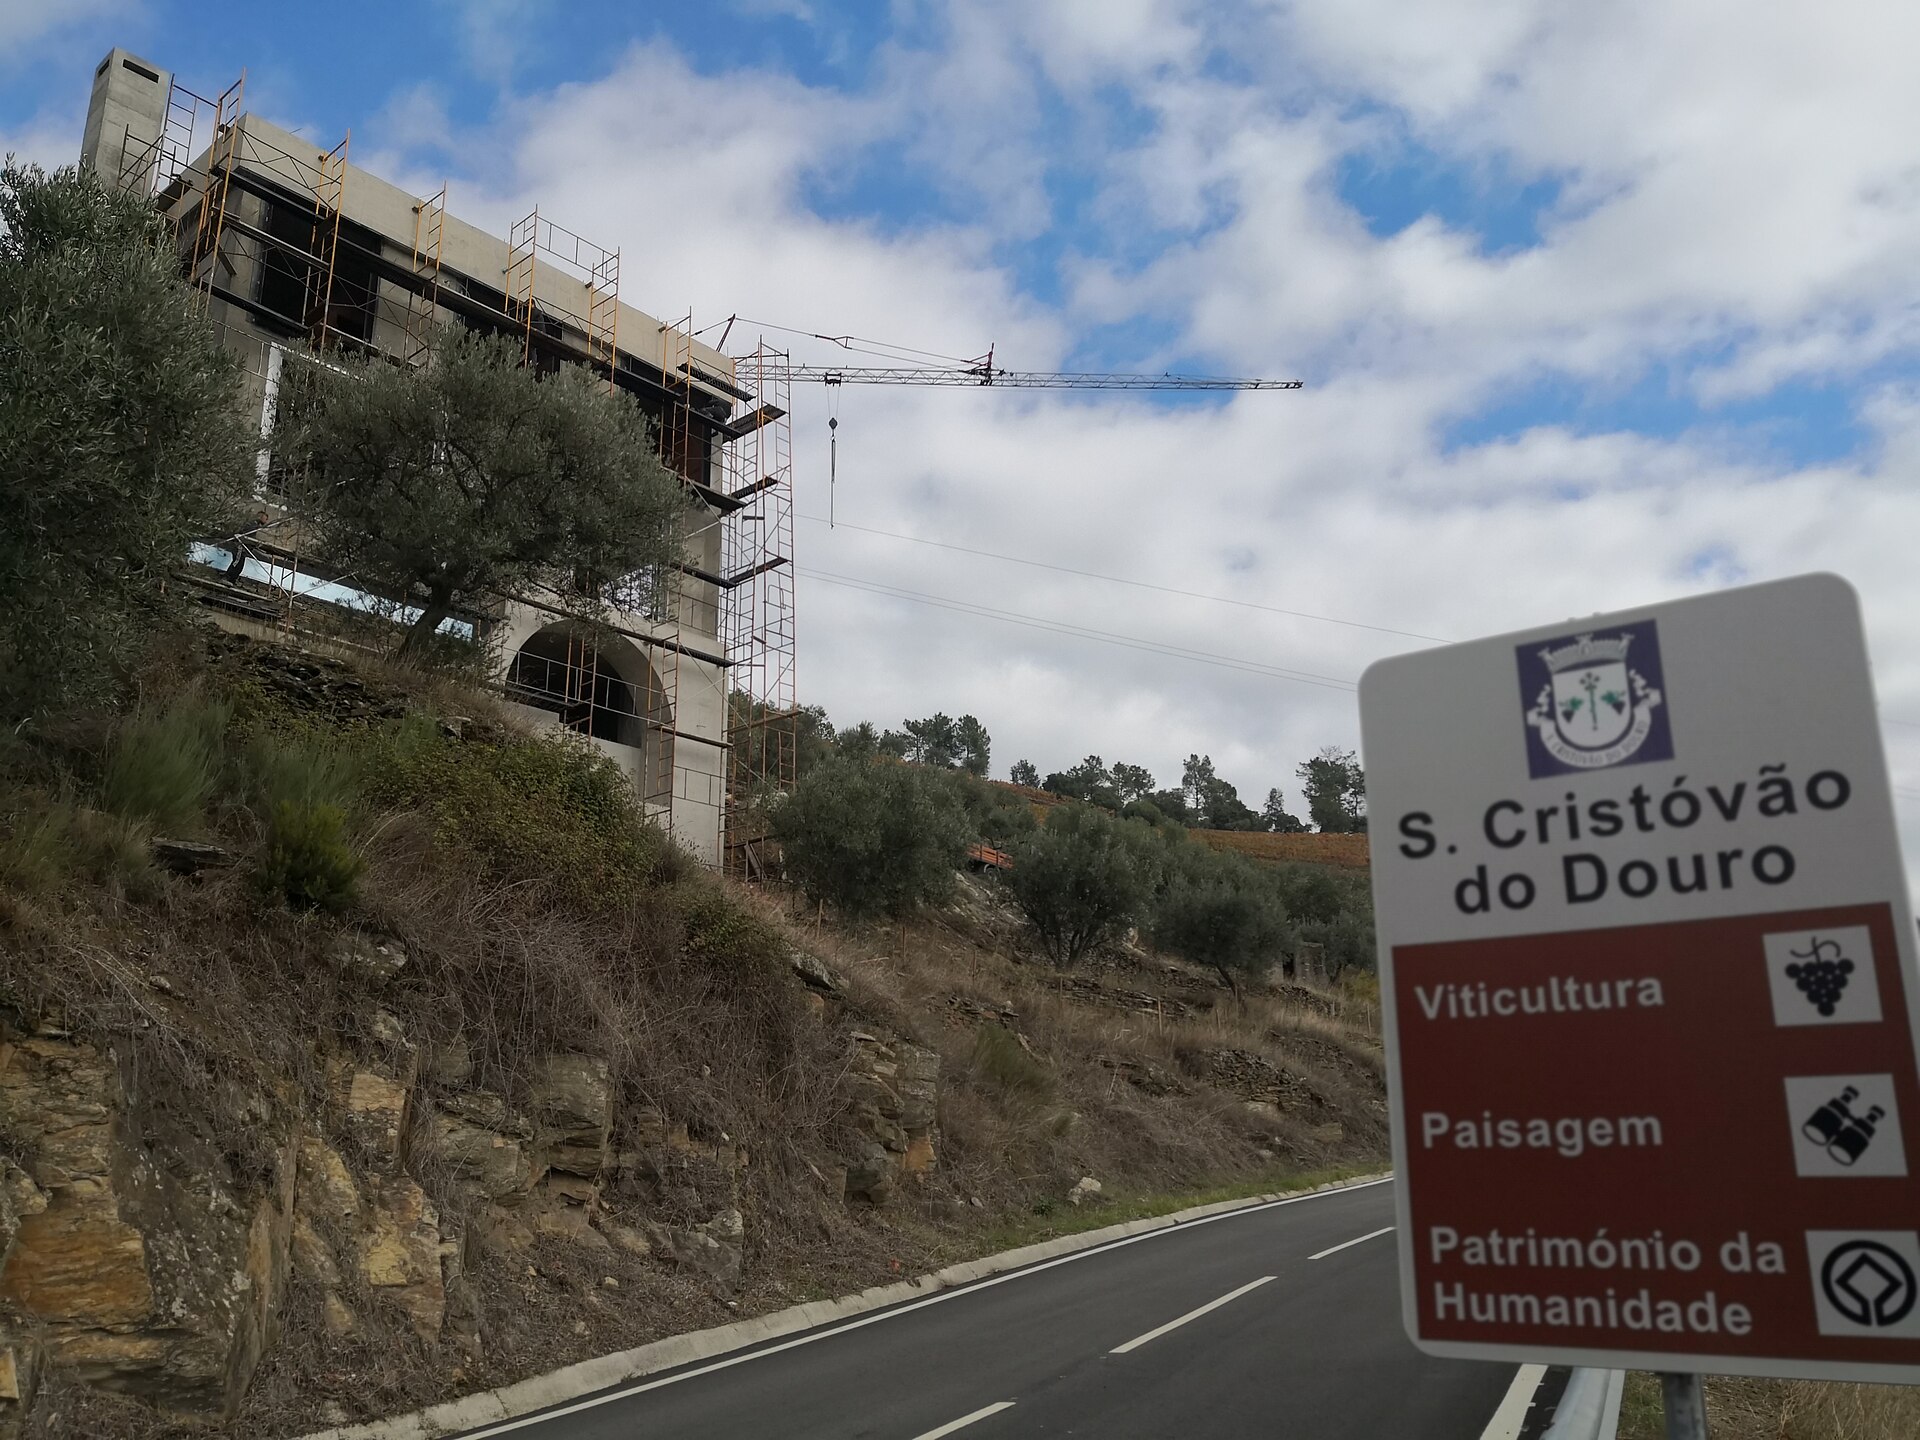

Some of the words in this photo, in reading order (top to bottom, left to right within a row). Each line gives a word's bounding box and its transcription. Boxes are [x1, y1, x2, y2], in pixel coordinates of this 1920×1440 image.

[1398, 811, 1459, 860] S.
[1483, 762, 1852, 850] Cristóvão
[1454, 864, 1537, 915] do
[1562, 844, 1796, 905] Douro
[1415, 977, 1664, 1019] Viticultura
[1422, 1111, 1663, 1156] Paisagem
[1431, 1227, 1701, 1271] Património
[1720, 1232, 1785, 1273] da
[1435, 1282, 1752, 1335] Humanidade
